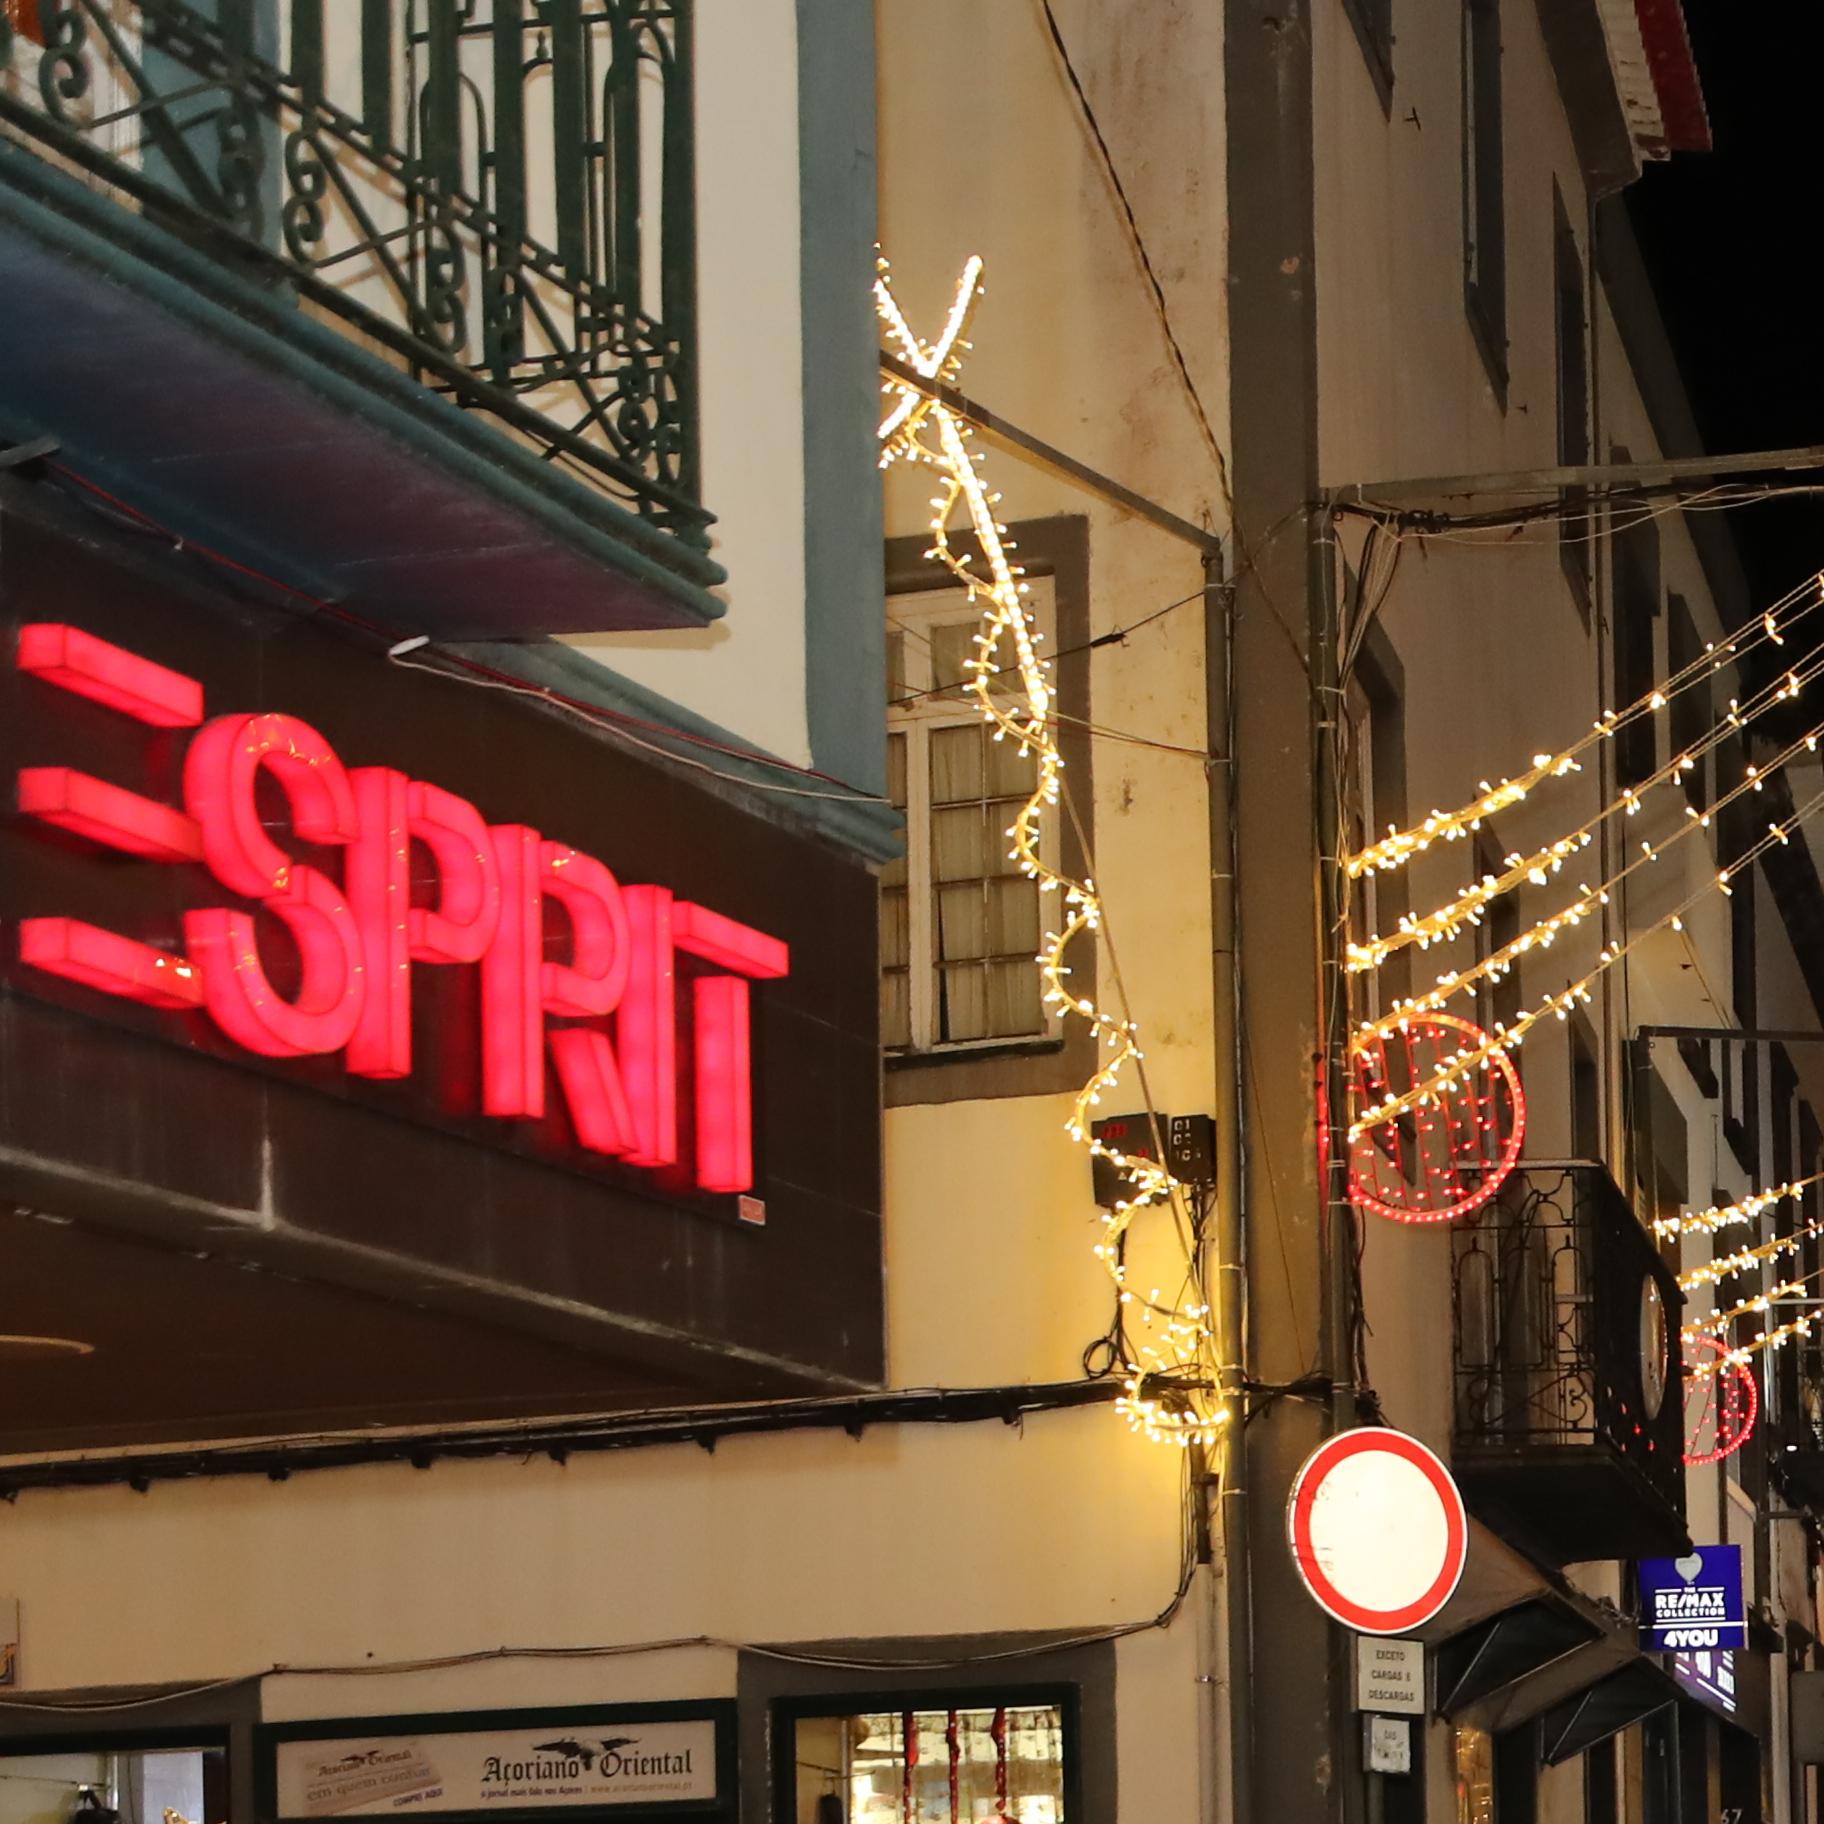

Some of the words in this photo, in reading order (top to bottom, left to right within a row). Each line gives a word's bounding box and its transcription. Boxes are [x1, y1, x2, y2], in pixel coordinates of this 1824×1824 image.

[17, 622, 790, 1194] ESPRIT
[1655, 1592, 1726, 1609] RE/MAX
[1655, 1606, 1726, 1618] COLLECTION
[1663, 1628, 1720, 1648] 4YOU
[1375, 1649, 1406, 1662] EXCETO
[1371, 1669, 1403, 1681] CARGAS
[1367, 1688, 1415, 1702] DESCARGAS
[480, 1755, 580, 1786] Açoriano
[600, 1748, 693, 1778] Oriental
